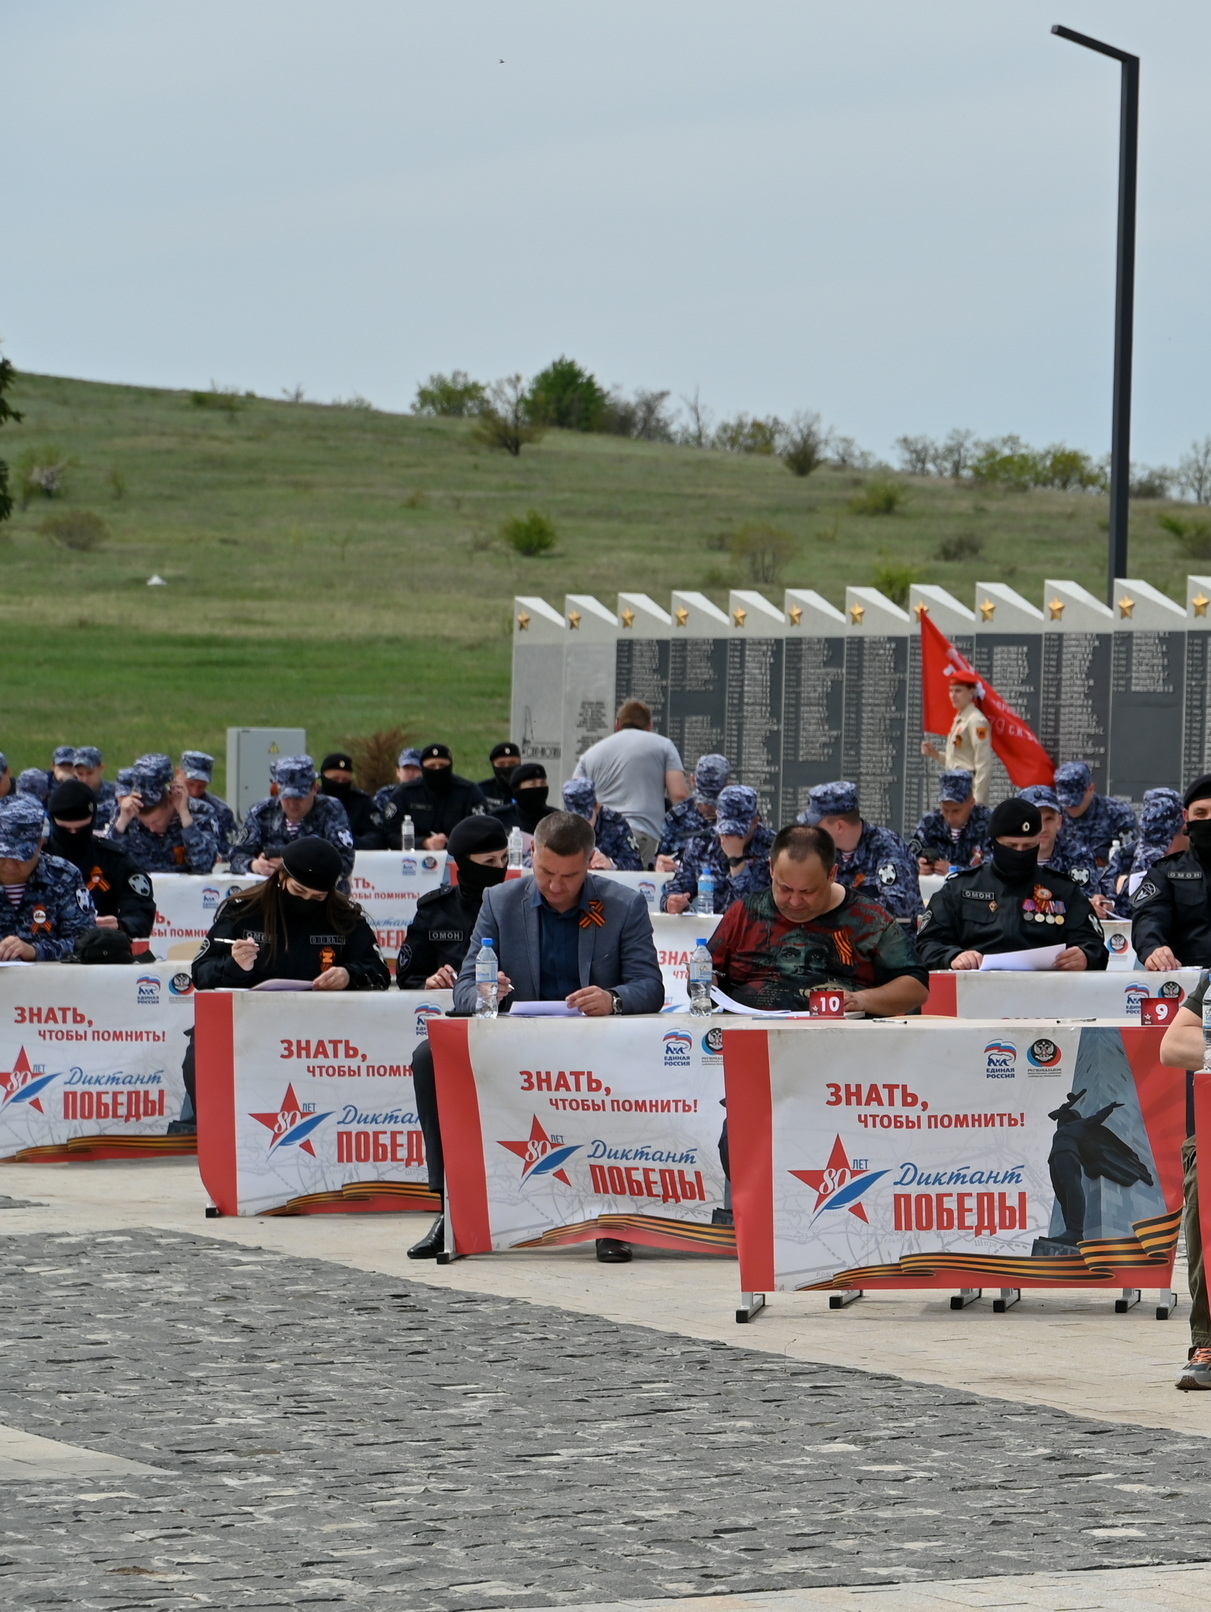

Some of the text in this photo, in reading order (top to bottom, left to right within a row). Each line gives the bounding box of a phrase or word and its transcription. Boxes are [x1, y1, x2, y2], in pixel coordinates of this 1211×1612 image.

[352, 892, 420, 900] ОБЫ ПОМНИТЬ!
[965, 890, 992, 900] ОМОН
[170, 928, 209, 938] ПОМНИ
[819, 996, 840, 1012] 10
[1156, 1003, 1169, 1020] 9
[14, 1006, 94, 1027] ЗНАТЬ,
[38, 1029, 166, 1042] ЧТОБЫ ПОМНИТЬ!
[280, 1039, 368, 1062] ЗНАТЬ,
[7, 1064, 46, 1091] 80 ЛЕТ
[64, 1067, 164, 1085] Диктант
[307, 1065, 413, 1077] ЧТОБЫ ПОМН
[519, 1070, 612, 1096] ЗНАТЬ,
[63, 1090, 165, 1123] ПОБЕДЫ
[549, 1098, 699, 1113] ЧТОБЫ ПОМНИТЬ!
[826, 1083, 929, 1112] ЗНАТЬ,
[274, 1103, 316, 1133] 80 ЛЕТ
[857, 1112, 1025, 1129] ЧТОБЫ ПОМНИТЬ!
[337, 1131, 425, 1168] ПОБЕД
[525, 1134, 565, 1161] 80 ЛЕТ
[587, 1140, 697, 1165] Диктант
[589, 1164, 707, 1204] ПОБЕДЫ
[819, 1159, 870, 1195] 80 ЛЕТ
[893, 1162, 1025, 1186] Диктант
[893, 1192, 1027, 1238] ПОБЕДЫ
